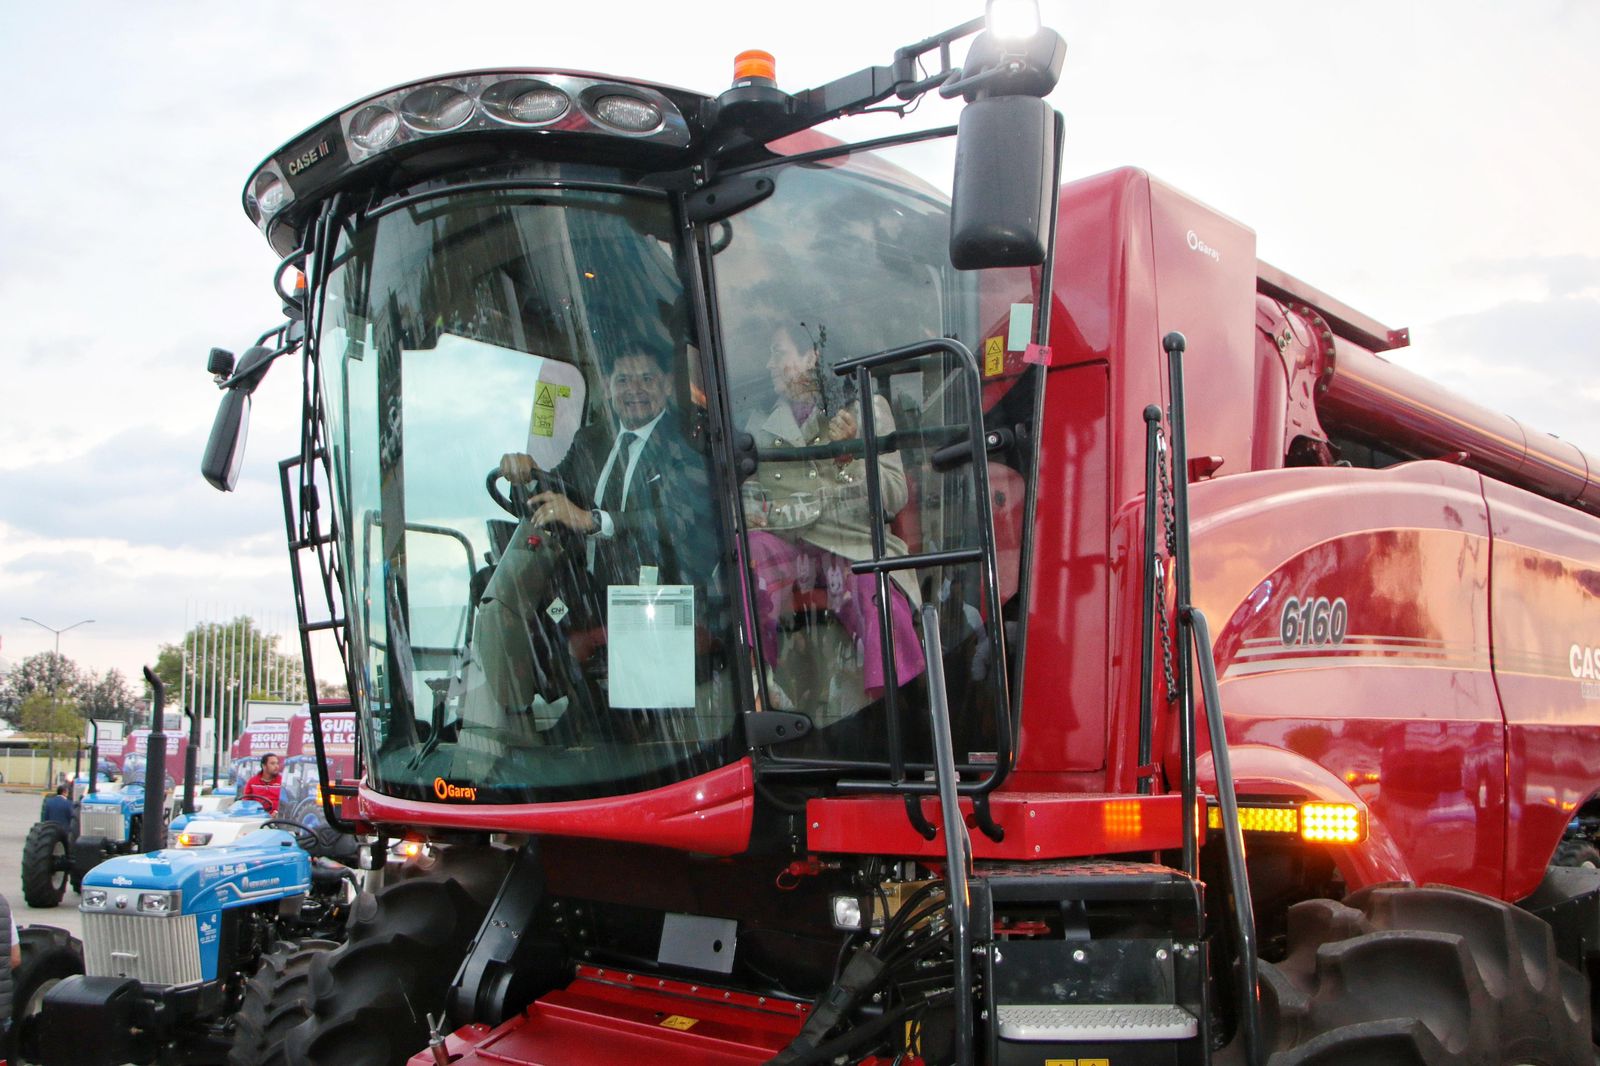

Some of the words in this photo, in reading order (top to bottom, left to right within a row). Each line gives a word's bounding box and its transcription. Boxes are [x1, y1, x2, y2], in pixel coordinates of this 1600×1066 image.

[288, 149, 318, 176] CASE
[1280, 596, 1347, 648] 6160
[302, 732, 332, 743] PAA
[447, 784, 476, 800] Garay
